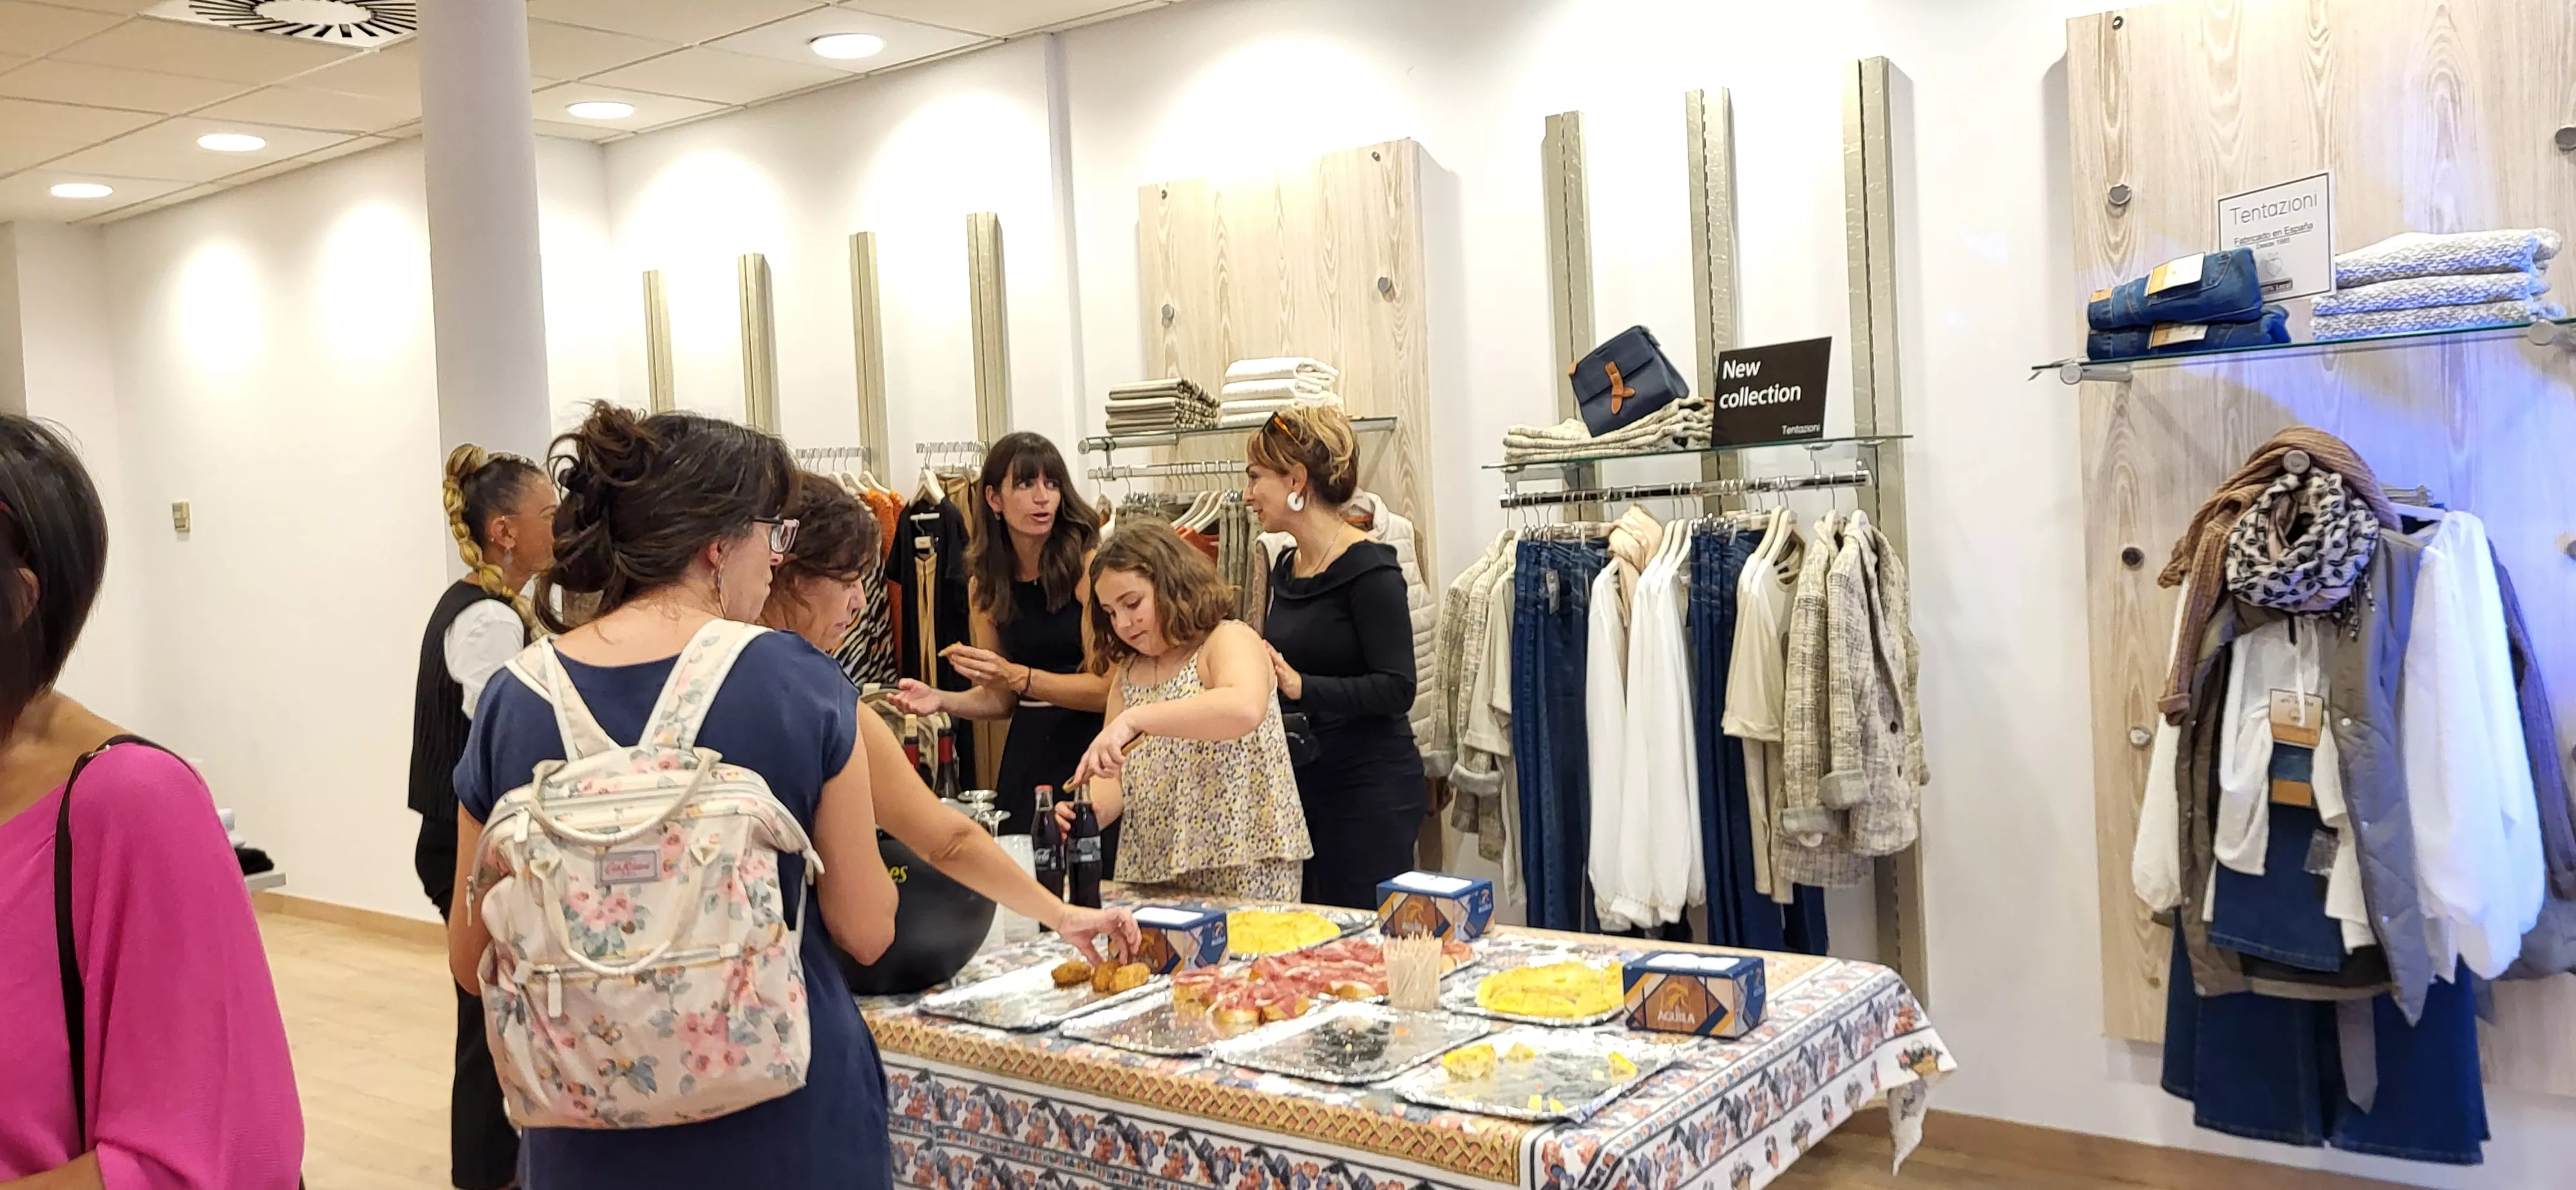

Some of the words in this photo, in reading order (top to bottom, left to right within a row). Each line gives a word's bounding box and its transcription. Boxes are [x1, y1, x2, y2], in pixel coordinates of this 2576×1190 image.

[2229, 191, 2318, 225] Tentazioni
[1723, 359, 1761, 380] New
[1719, 382, 1802, 410] collection
[1781, 423, 1821, 435] Tentazioni
[889, 865, 908, 883] es
